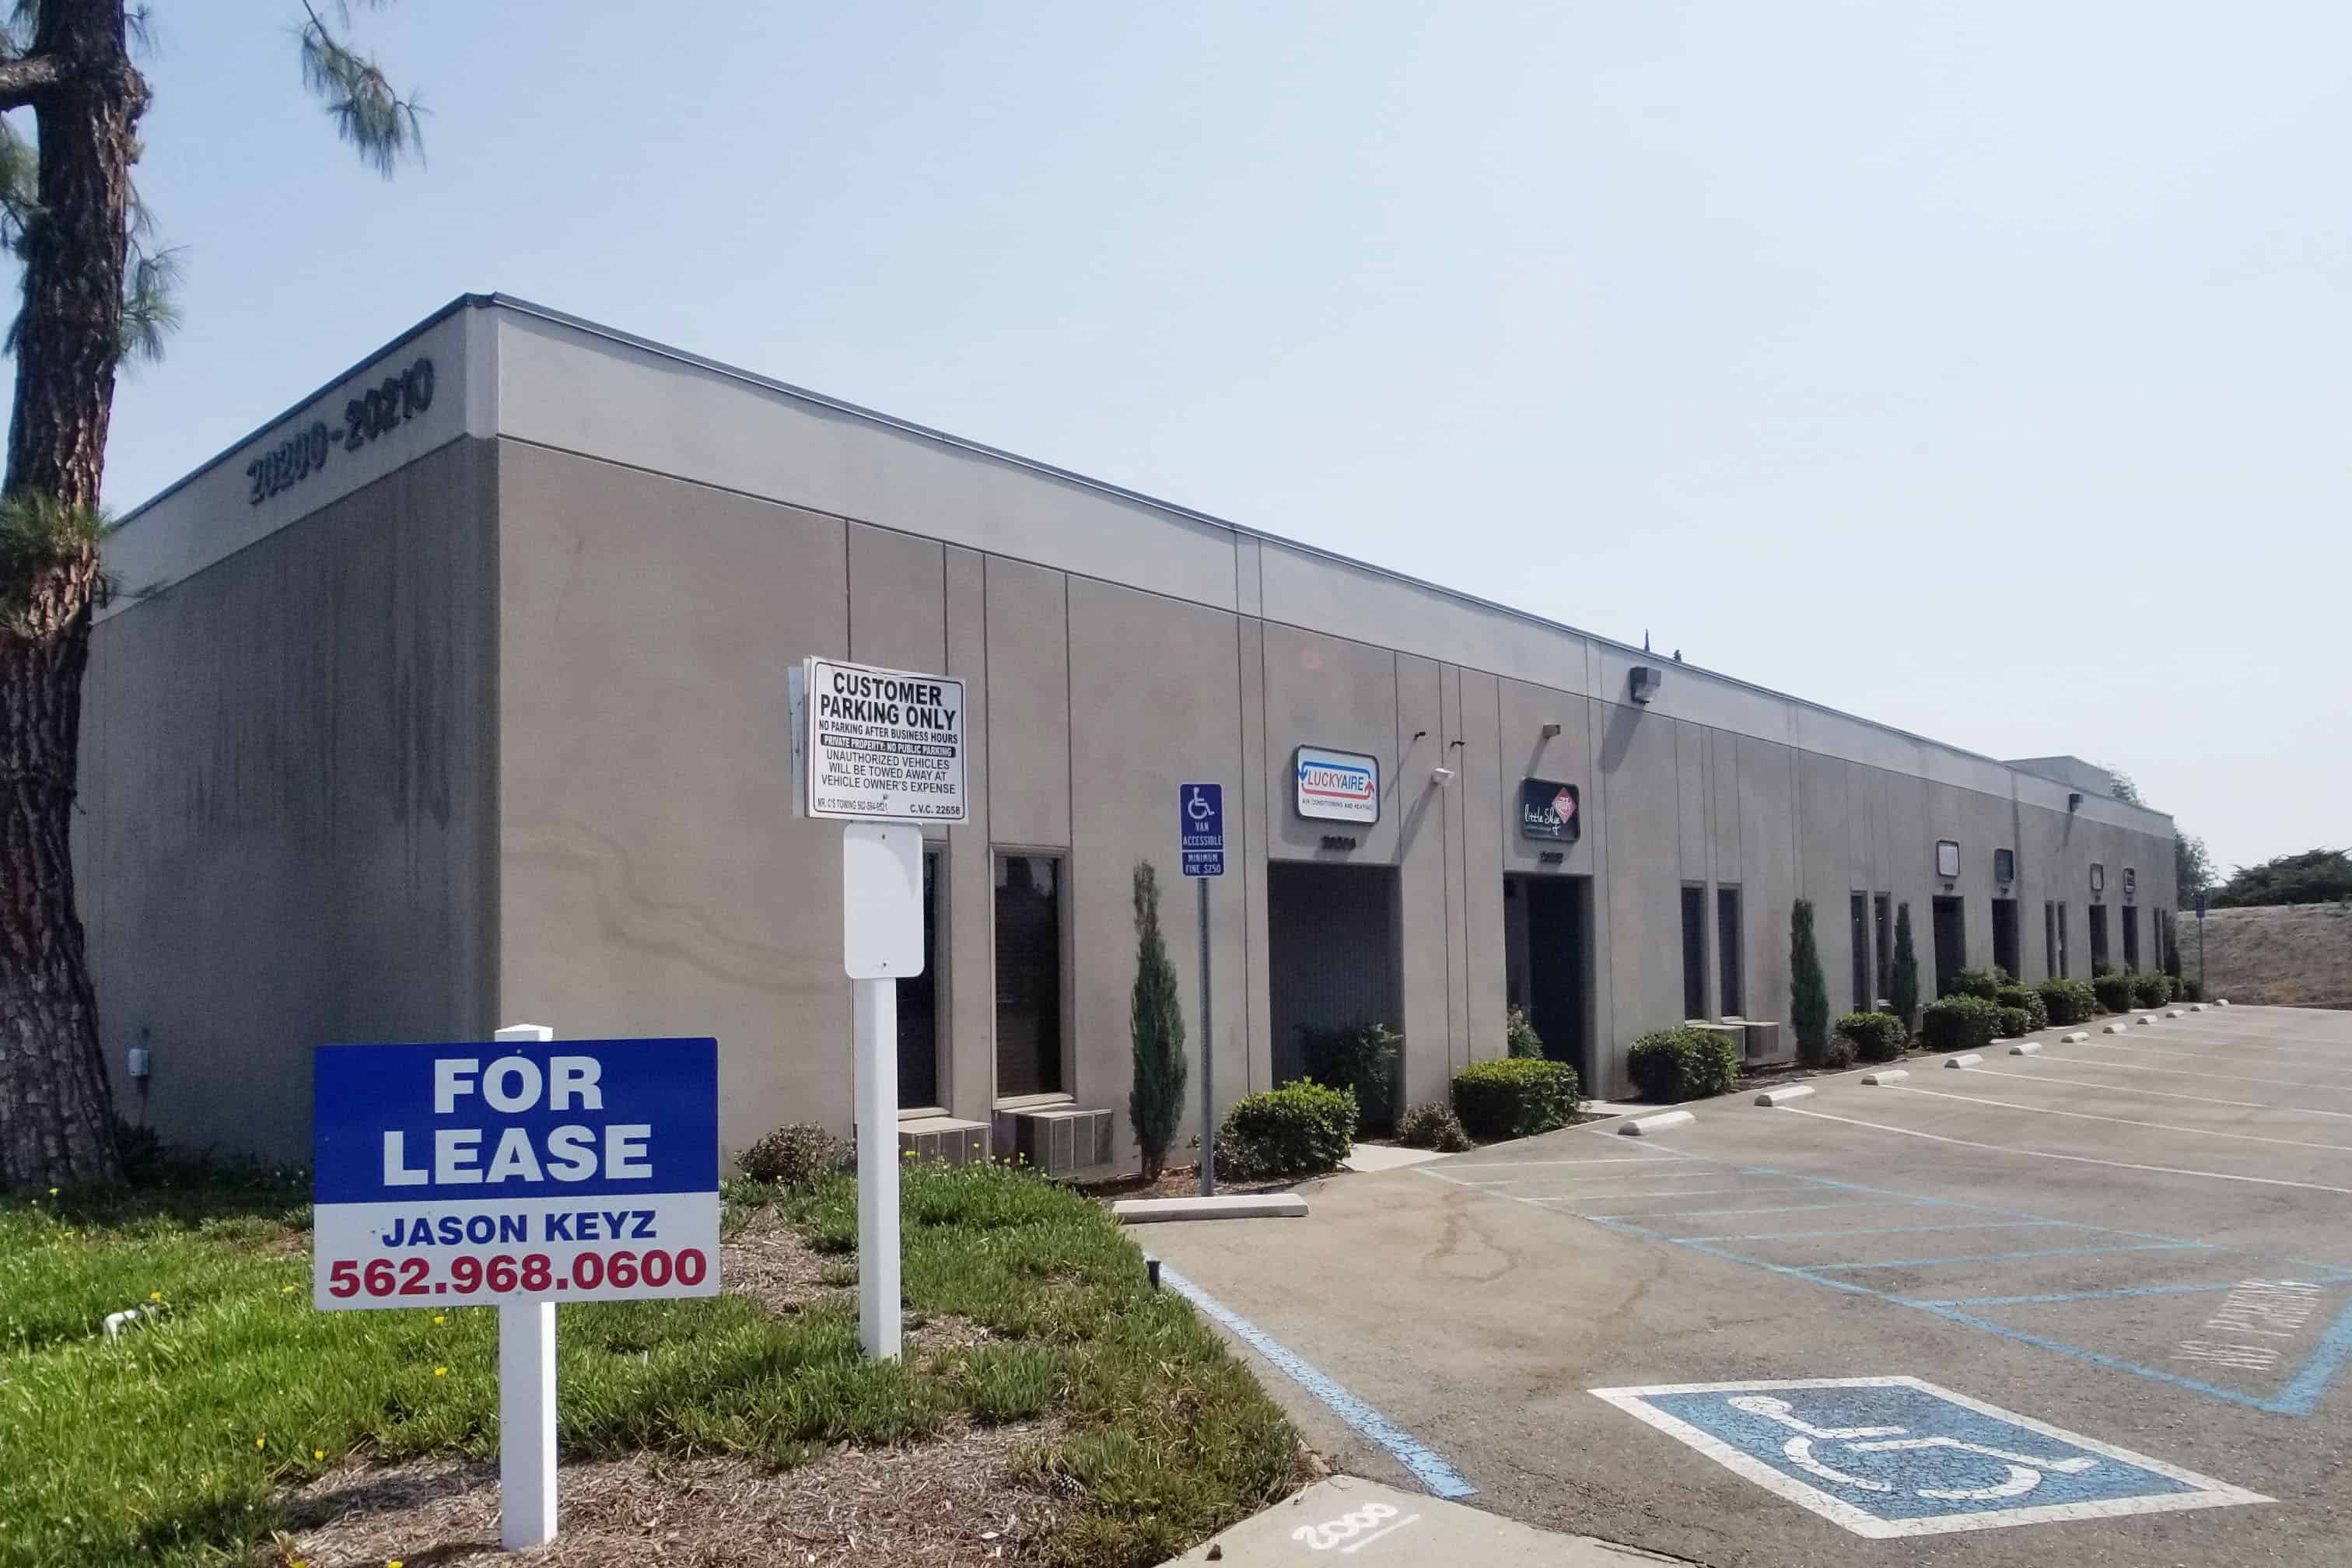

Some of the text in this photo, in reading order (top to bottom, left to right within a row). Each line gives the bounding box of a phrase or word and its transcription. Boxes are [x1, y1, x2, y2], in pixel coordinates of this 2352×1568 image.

[834, 672, 943, 706] CUSTOMER
[821, 694, 956, 730] PARKING ONLY
[819, 719, 958, 744] NO PARKING AFTER BUSINESS HOURS
[824, 737, 850, 747] PRIVATE
[887, 743, 897, 751] NO
[898, 744, 922, 754] PUBLIC
[923, 747, 953, 757] PARKING
[827, 749, 950, 770] UNAUTHORIZED VEHICLES
[828, 761, 947, 781] WILL BE TOWED AWAY AT
[1307, 769, 1363, 791] LUCKYAIRE
[821, 774, 956, 794] VEHICLE OWNER'S EXPENSE
[910, 804, 961, 815] C.V.C. 22658
[1195, 821, 1209, 832] VAN
[1182, 835, 1222, 846] ACCESSIBLE
[1188, 852, 1218, 863] MINIMUM
[1185, 864, 1221, 873] FINE $250
[434, 1055, 604, 1115] FOR
[383, 1124, 653, 1187] LEASE
[382, 1209, 657, 1248] JASON KEYZ
[329, 1248, 708, 1299] 562.968.0600
